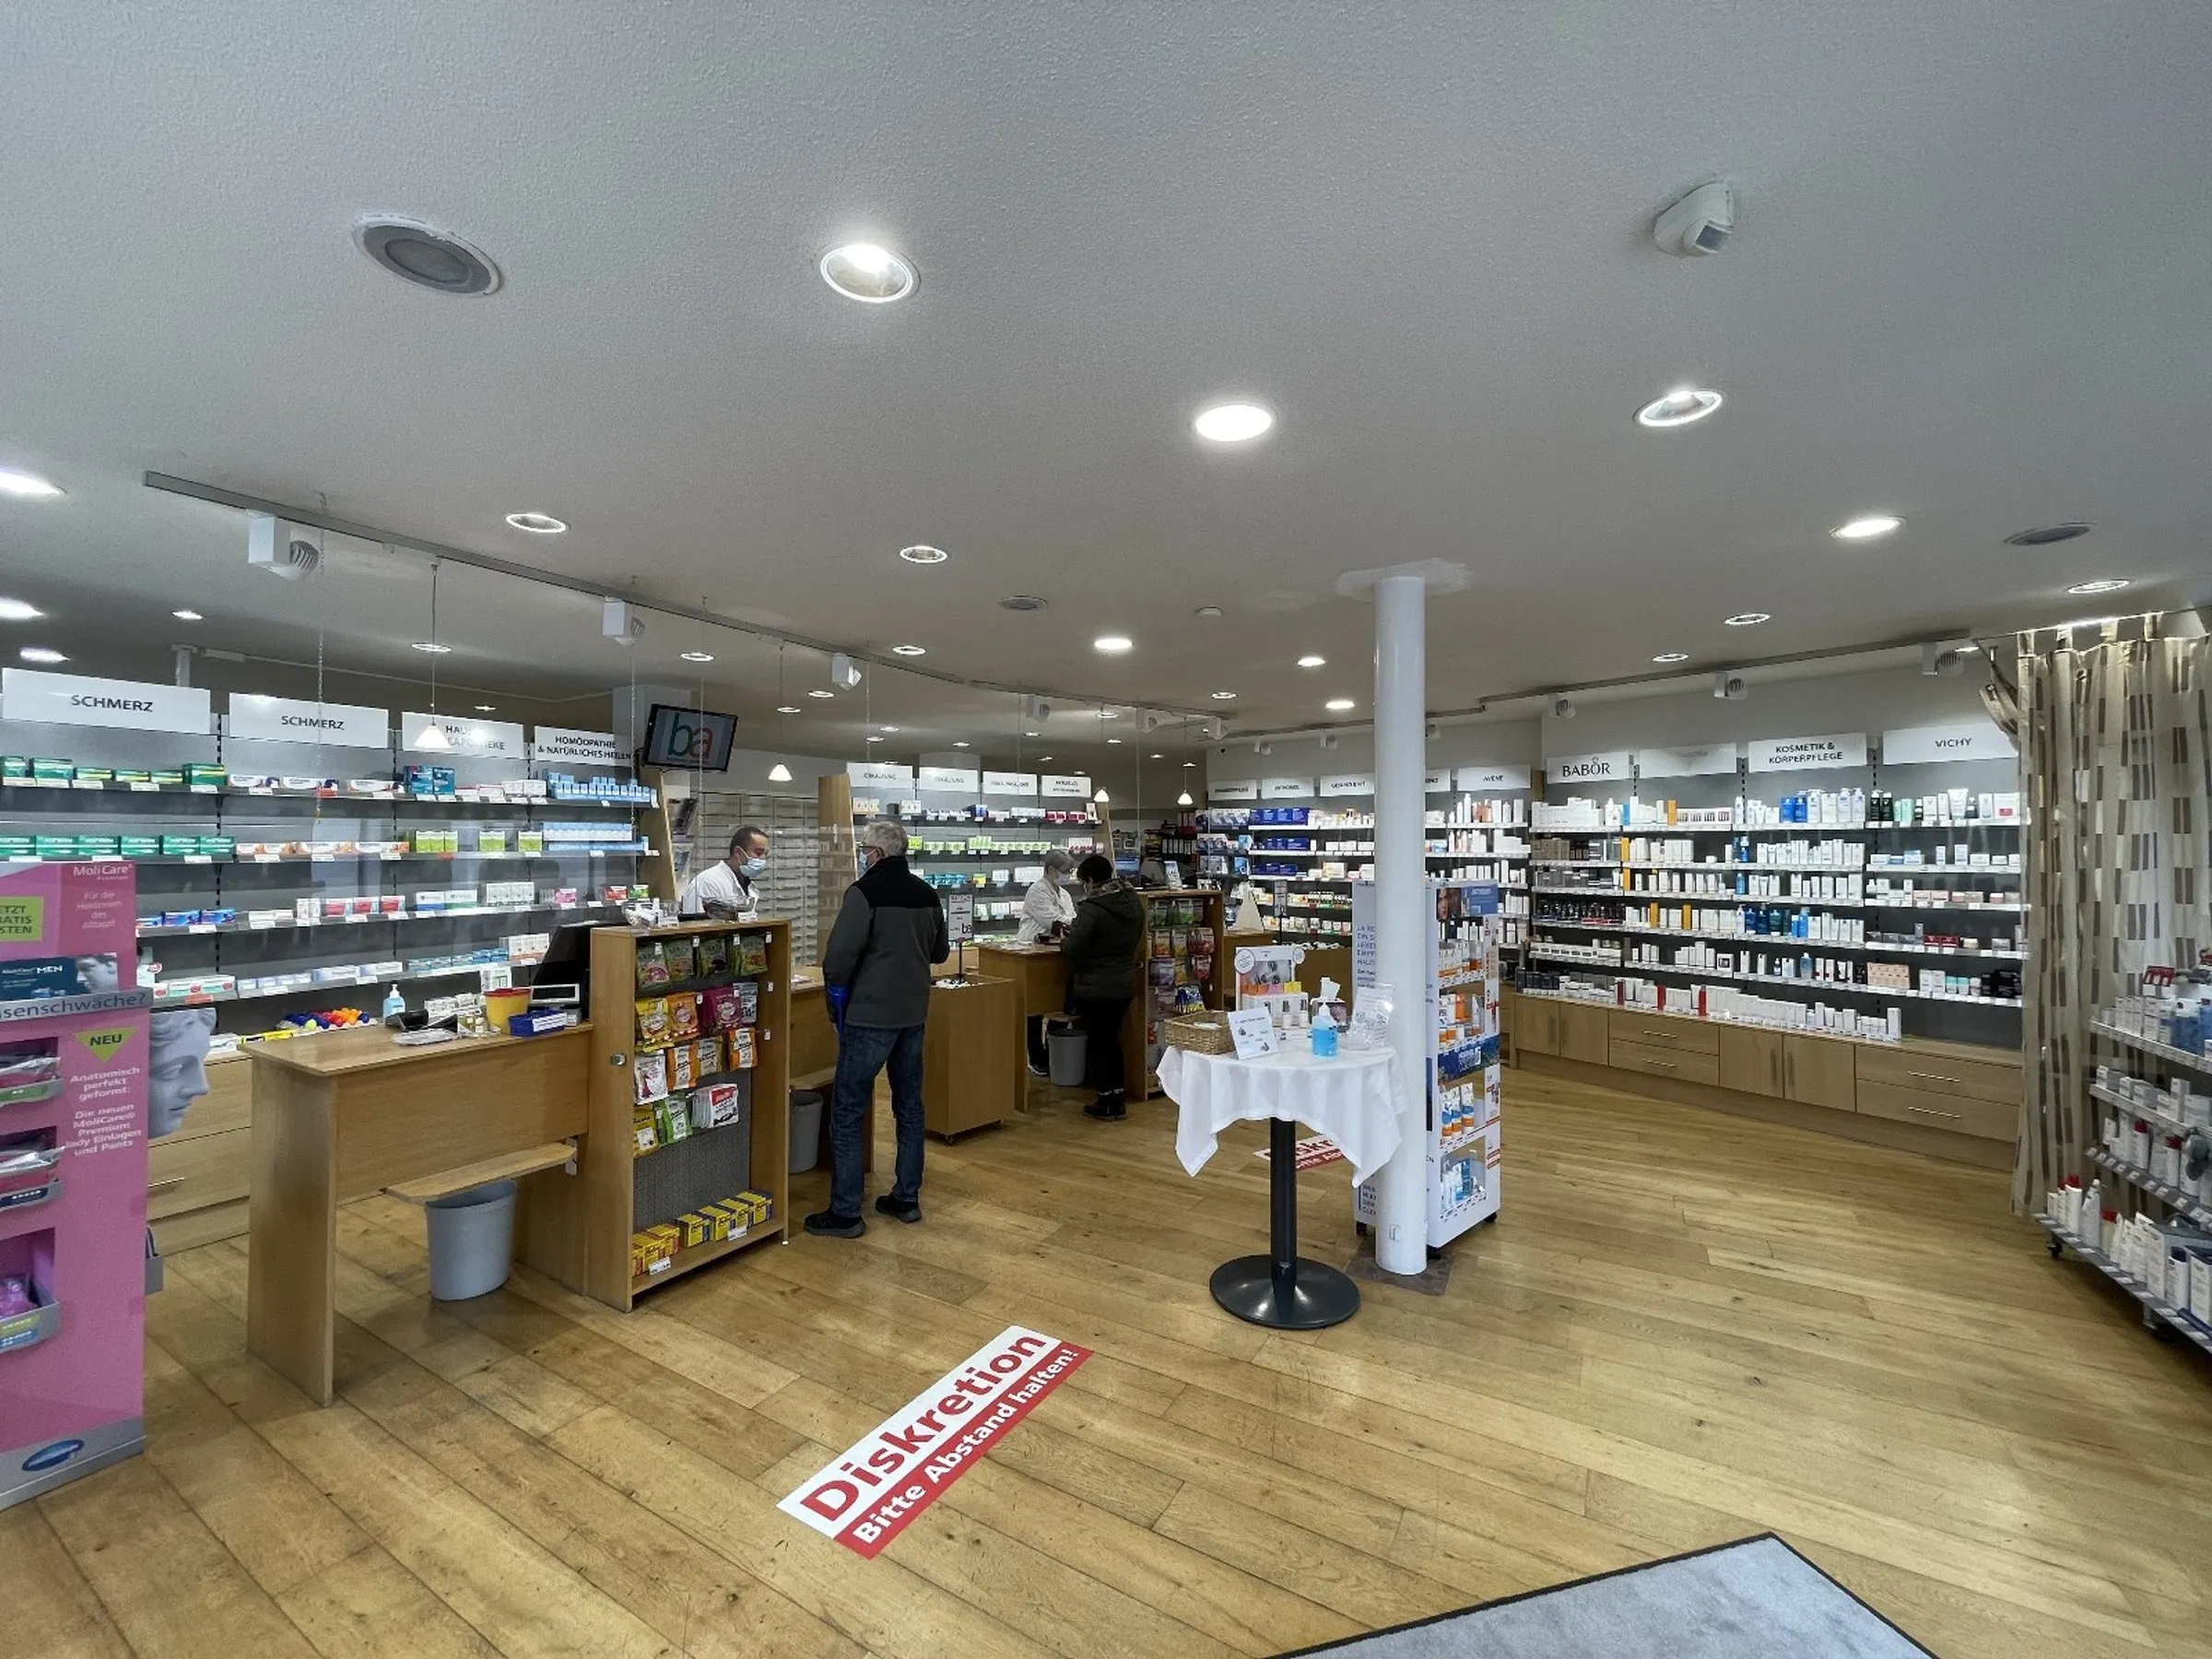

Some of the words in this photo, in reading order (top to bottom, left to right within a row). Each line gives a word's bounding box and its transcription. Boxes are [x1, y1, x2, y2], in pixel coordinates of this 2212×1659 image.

[71, 694, 153, 712] SCHMERZ
[281, 715, 346, 730] SCHMERZ
[555, 735, 617, 748] HOMÖOPATHIE
[667, 712, 712, 759] ba
[1775, 743, 1825, 753] KOSMETIK
[1827, 741, 1835, 750] &
[1935, 738, 1972, 748] VICHY
[537, 745, 545, 753] &
[547, 745, 602, 759] NATÜRLICHES
[1769, 751, 1842, 764] KÖRPERPFLEGE
[37, 965, 63, 974] MEN
[0, 992, 146, 1018] senschwäche?
[90, 1034, 122, 1046] NEU
[70, 1067, 140, 1083] Anatomisch
[84, 1077, 126, 1092] perfekt
[75, 1111, 95, 1119] Die
[77, 1122, 130, 1137] Premium
[74, 1144, 97, 1156] und
[800, 1336, 1046, 1522] Diskretion
[853, 1485, 926, 1544] Bitte
[924, 1402, 1018, 1484] Abstand
[1008, 1348, 1079, 1404] halten!
